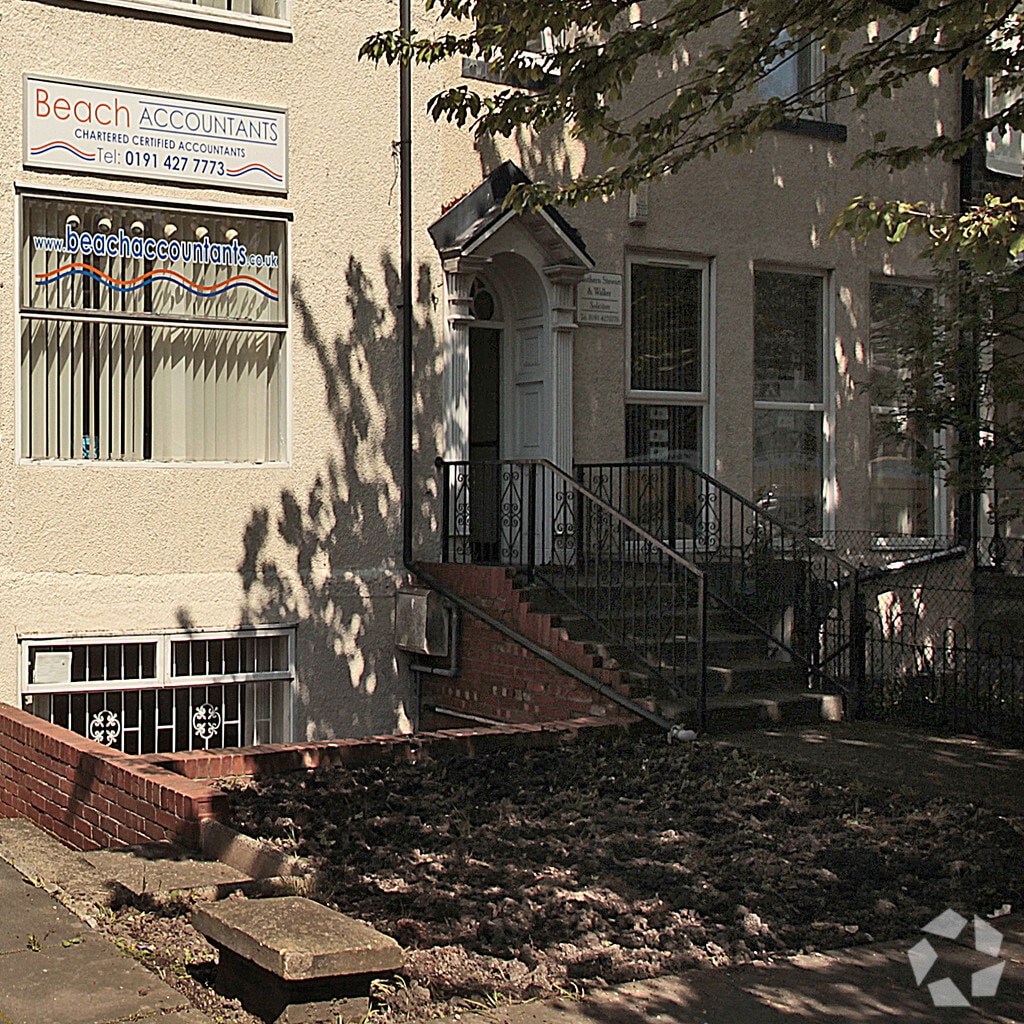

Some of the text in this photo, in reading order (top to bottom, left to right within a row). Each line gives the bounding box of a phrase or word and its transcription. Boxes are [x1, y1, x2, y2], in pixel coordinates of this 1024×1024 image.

[36, 88, 278, 142] Beach ACCOUNTANTS
[74, 129, 246, 158] CHARTERED CERTIFIED ACCOUNTANTS
[96, 147, 225, 176] Tel: 0191 427 7773
[33, 225, 278, 268] www.beachaccountants.co.uk
